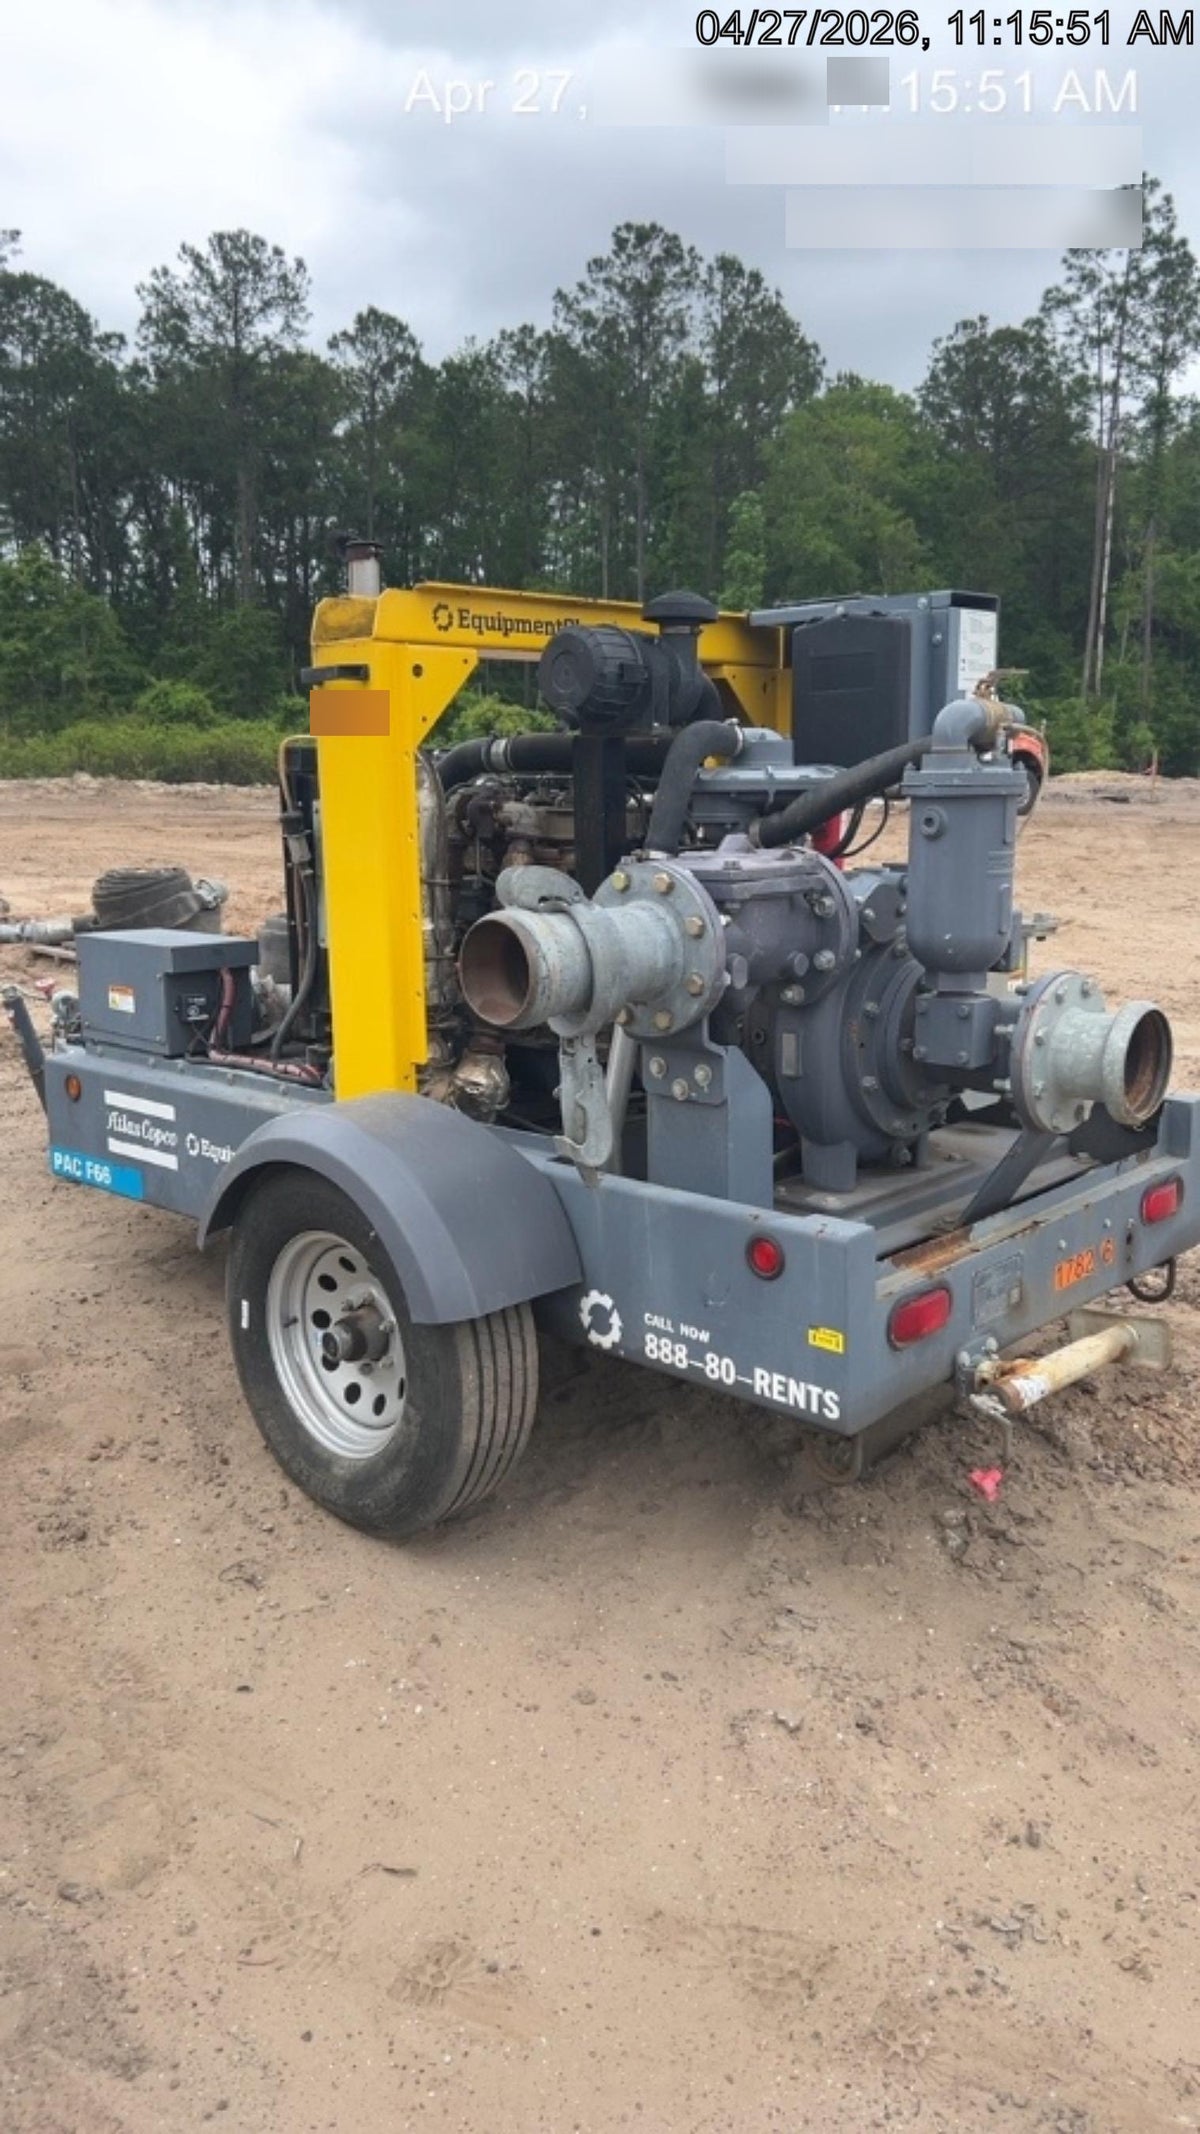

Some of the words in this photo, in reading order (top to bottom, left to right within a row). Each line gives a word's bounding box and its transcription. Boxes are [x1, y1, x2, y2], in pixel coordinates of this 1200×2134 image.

[107, 1111, 141, 1138] Atlas
[142, 1119, 178, 1147] Copco
[53, 1151, 82, 1177] PAC
[644, 1313, 674, 1333] CALL
[680, 1322, 710, 1342] NOW
[644, 1333, 840, 1420] 888-80-RENTS
